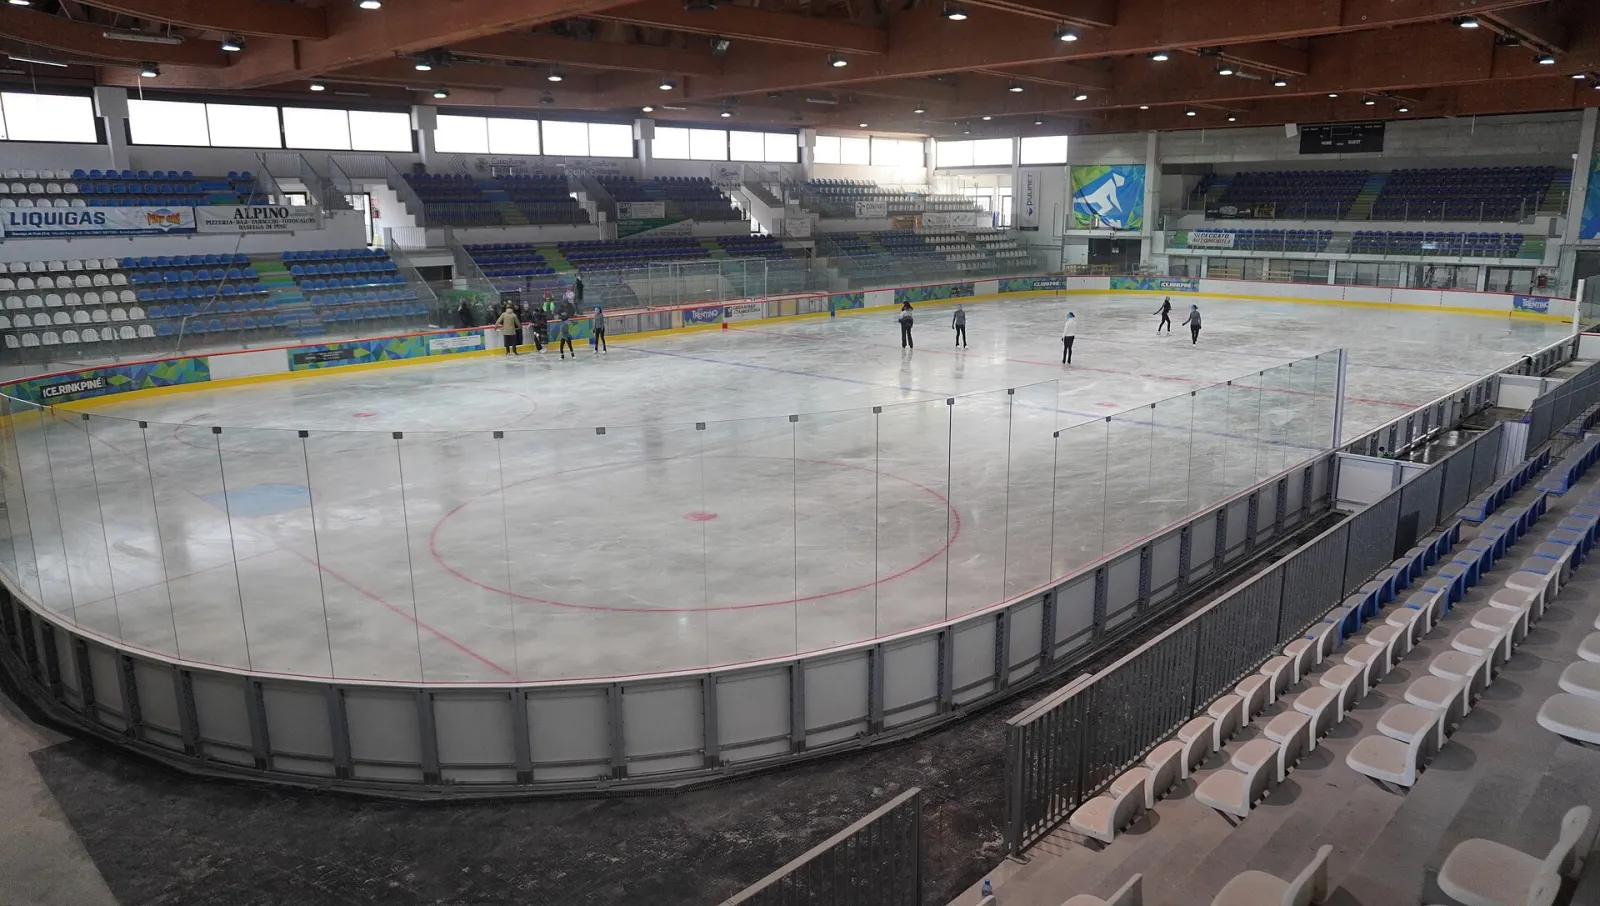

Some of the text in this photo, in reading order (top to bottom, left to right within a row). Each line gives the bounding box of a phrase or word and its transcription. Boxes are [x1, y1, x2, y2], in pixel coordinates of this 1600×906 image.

[10, 211, 106, 228] LIQUIGAS
[234, 207, 289, 220] ALPINO
[691, 309, 719, 320] TRENTINO
